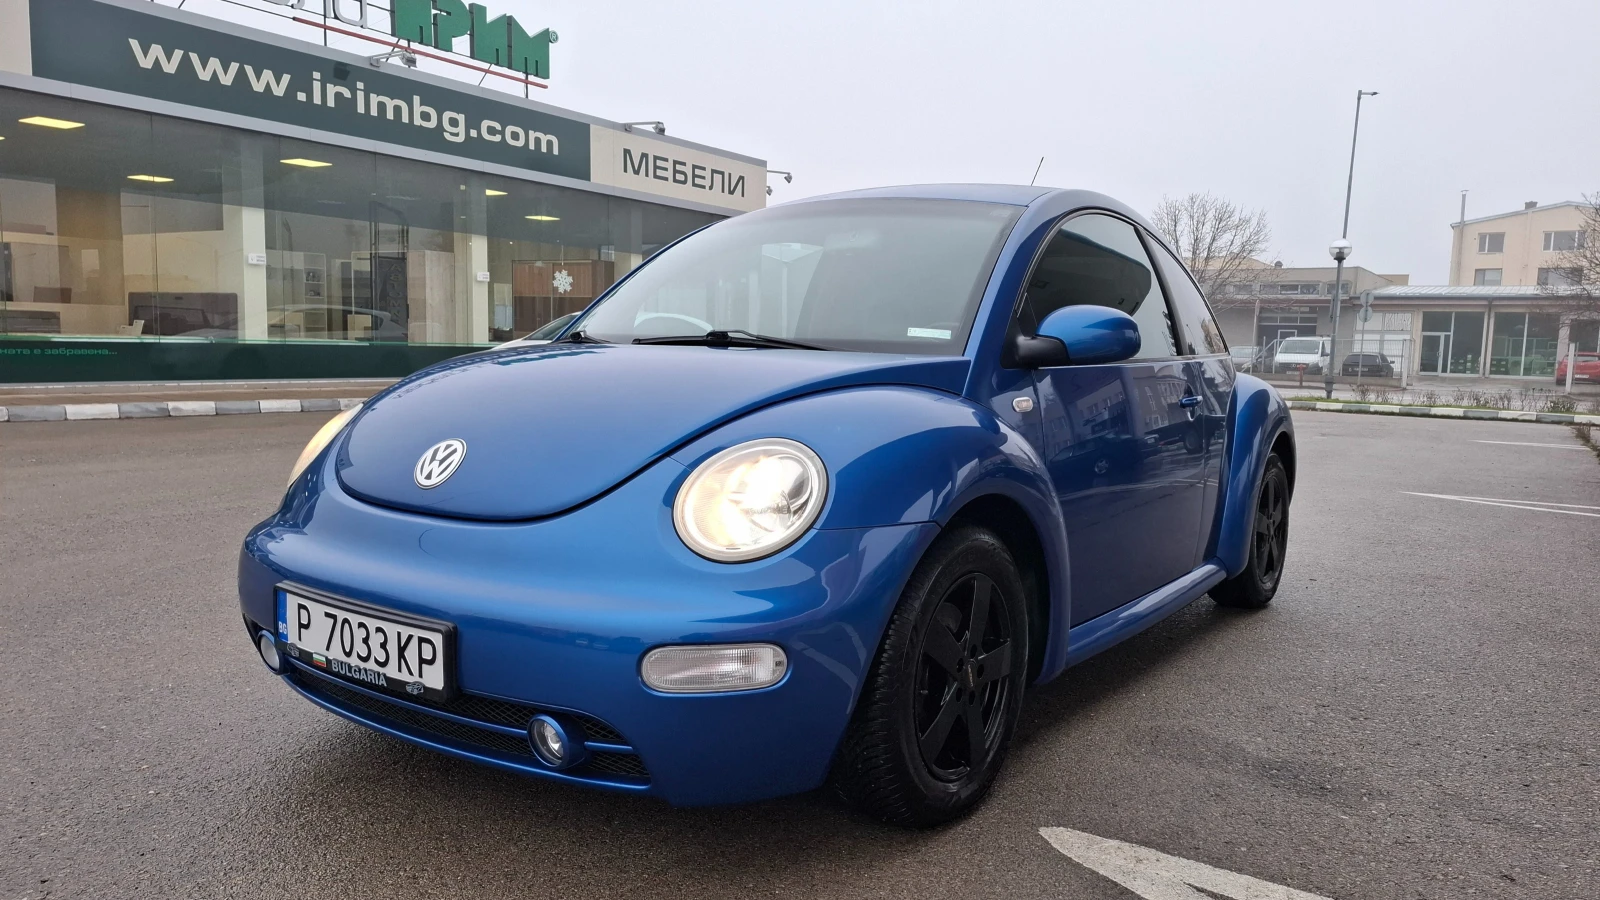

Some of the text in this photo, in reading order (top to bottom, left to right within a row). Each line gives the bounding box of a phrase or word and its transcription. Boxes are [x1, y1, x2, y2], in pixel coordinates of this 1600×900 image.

[128, 38, 559, 155] www.irimbg.com
[623, 148, 745, 198] МЕБЕЛИ
[278, 621, 288, 635] BG
[297, 602, 437, 679] P 7033 KP
[331, 658, 387, 687] BULGARIA
